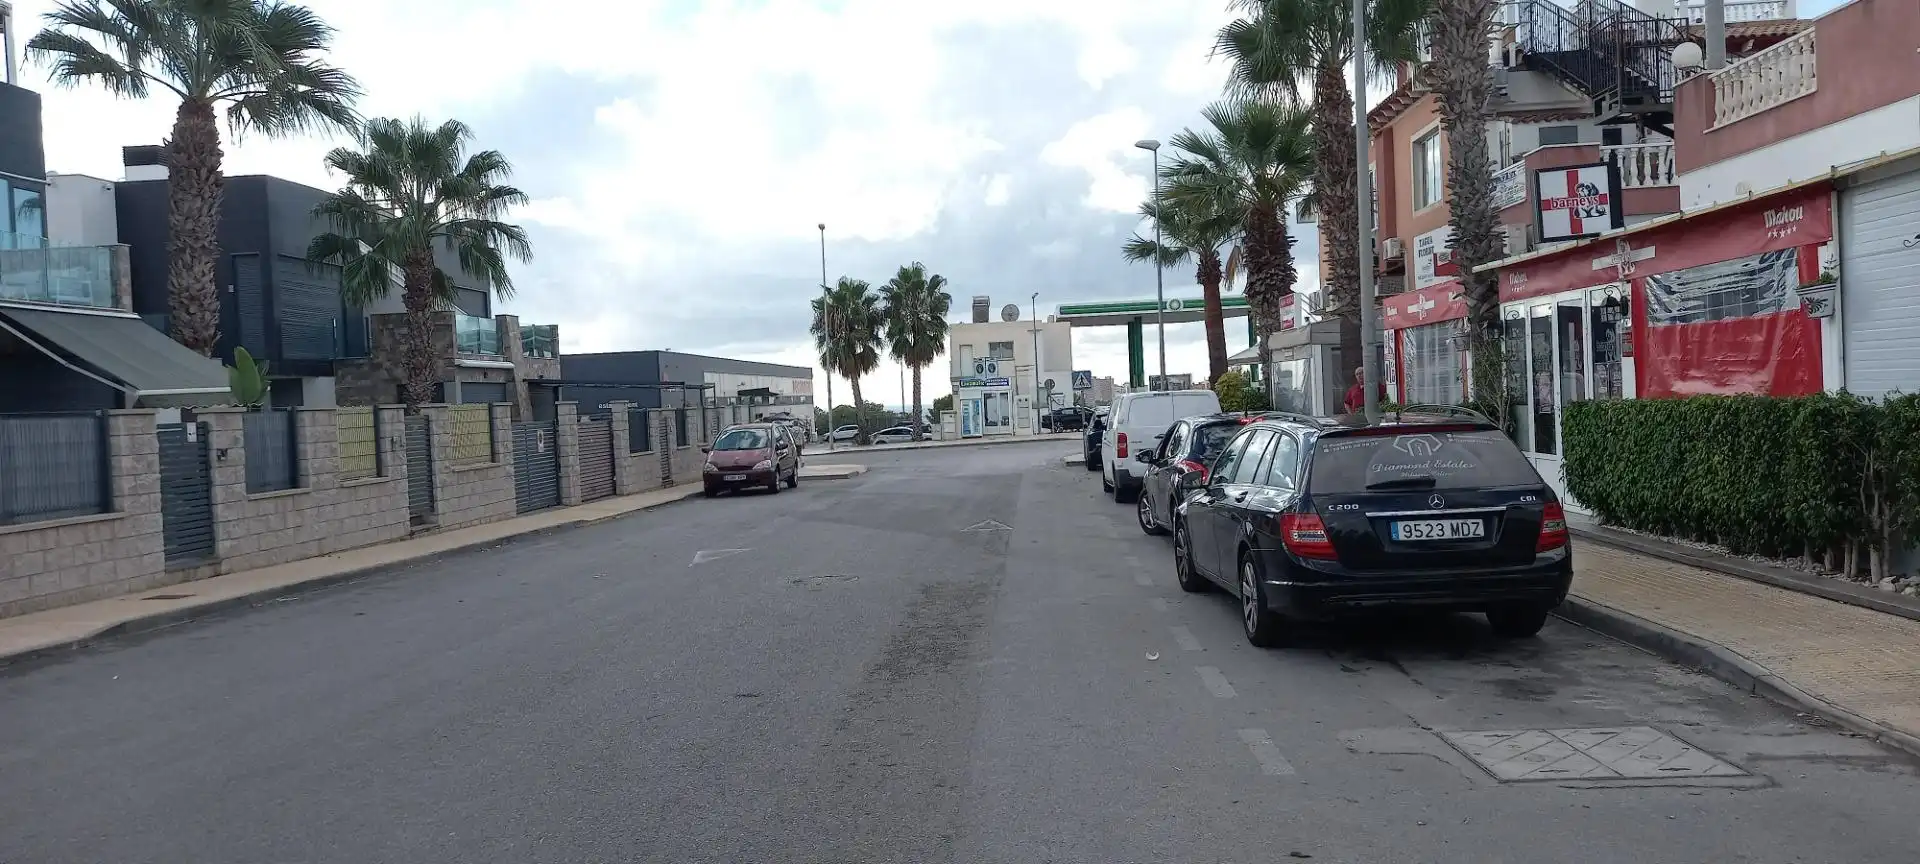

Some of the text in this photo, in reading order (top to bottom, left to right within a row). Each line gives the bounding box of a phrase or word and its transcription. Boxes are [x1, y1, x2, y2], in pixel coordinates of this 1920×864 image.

[1551, 196, 1600, 209] barneys
[1763, 205, 1803, 228] Mahou
[1371, 459, 1476, 473] Diamond Estates
[1402, 521, 1482, 539] 9523 MDZ
